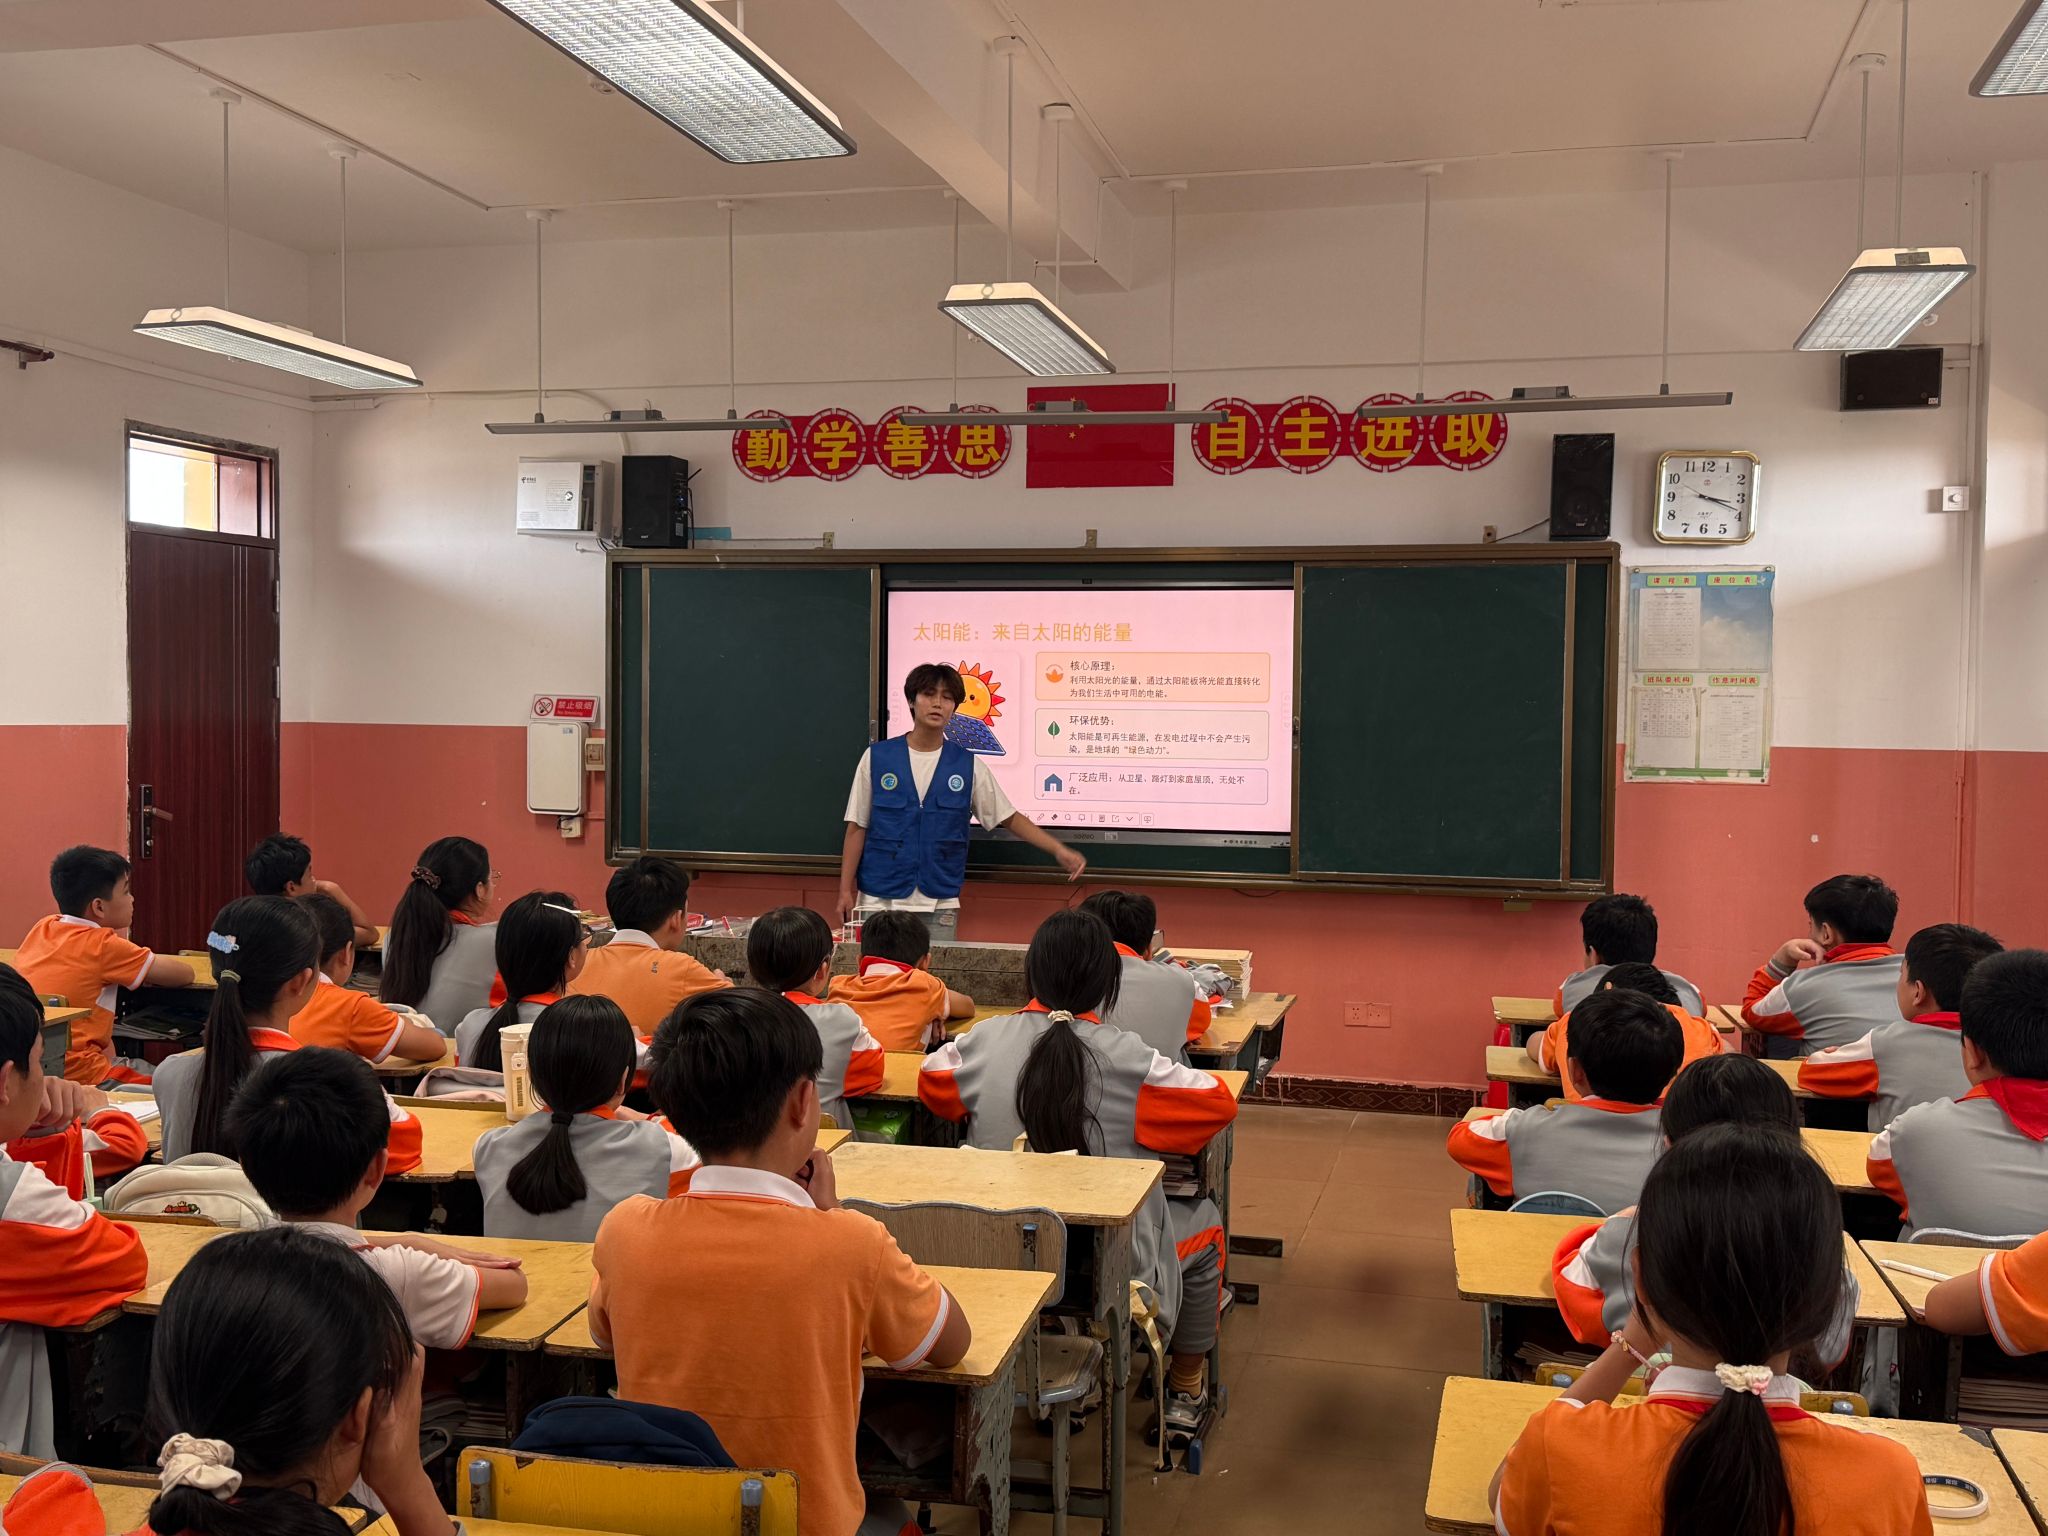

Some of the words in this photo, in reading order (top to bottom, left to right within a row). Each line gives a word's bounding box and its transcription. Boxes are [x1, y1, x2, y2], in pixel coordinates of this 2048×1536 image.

[1209, 408, 1497, 459] 自主进取
[746, 420, 1001, 470] 勤学善思
[1685, 461, 1696, 472] 11
[1702, 460, 1716, 473] 12
[1725, 462, 1730, 473] 1
[1668, 473, 1680, 484] 10
[1737, 474, 1746, 485] 2
[1667, 491, 1676, 502] 9
[1736, 493, 1745, 504] 3
[1667, 510, 1676, 520] 8
[1734, 511, 1742, 521] 4
[1681, 523, 1690, 534] 7
[1699, 523, 1708, 534] 6
[1718, 524, 1727, 534] 5
[912, 621, 1133, 642] 太阳能：来自太阳的能量
[1070, 660, 1115, 672] 核心原理：
[1070, 675, 1261, 687] 利用太阳光的能量，通过太阳能板将光能直接转化
[1070, 688, 1168, 699] 为我们生活中可用的电能。
[1069, 715, 1115, 726] 环保优势：
[1069, 732, 1251, 744] 太阳能是可再生能源，在发电过程中不会产生污
